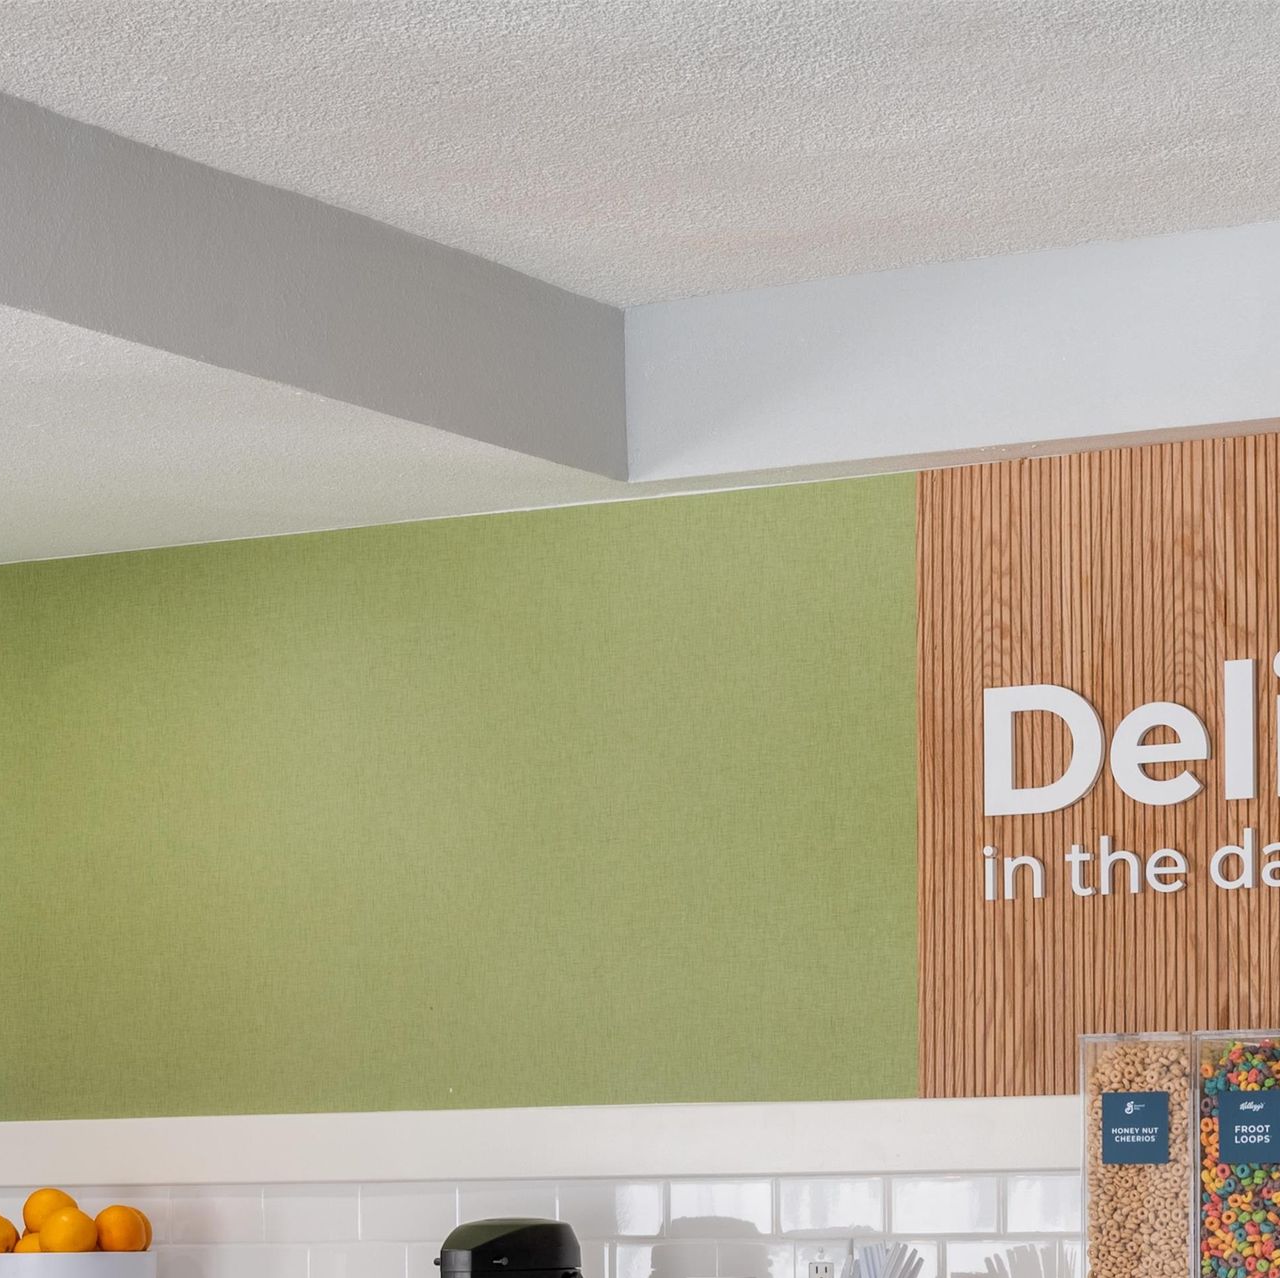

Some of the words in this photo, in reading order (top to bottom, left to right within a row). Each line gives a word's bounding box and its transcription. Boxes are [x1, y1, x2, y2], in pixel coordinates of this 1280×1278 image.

[983, 845, 1045, 900] in
[1065, 834, 1189, 897] the
[1111, 1127, 1140, 1135] HONEY
[1234, 1124, 1271, 1134] FROOT
[1114, 1135, 1156, 1143] CHEERIOS
[1234, 1134, 1271, 1144] LOOPS
